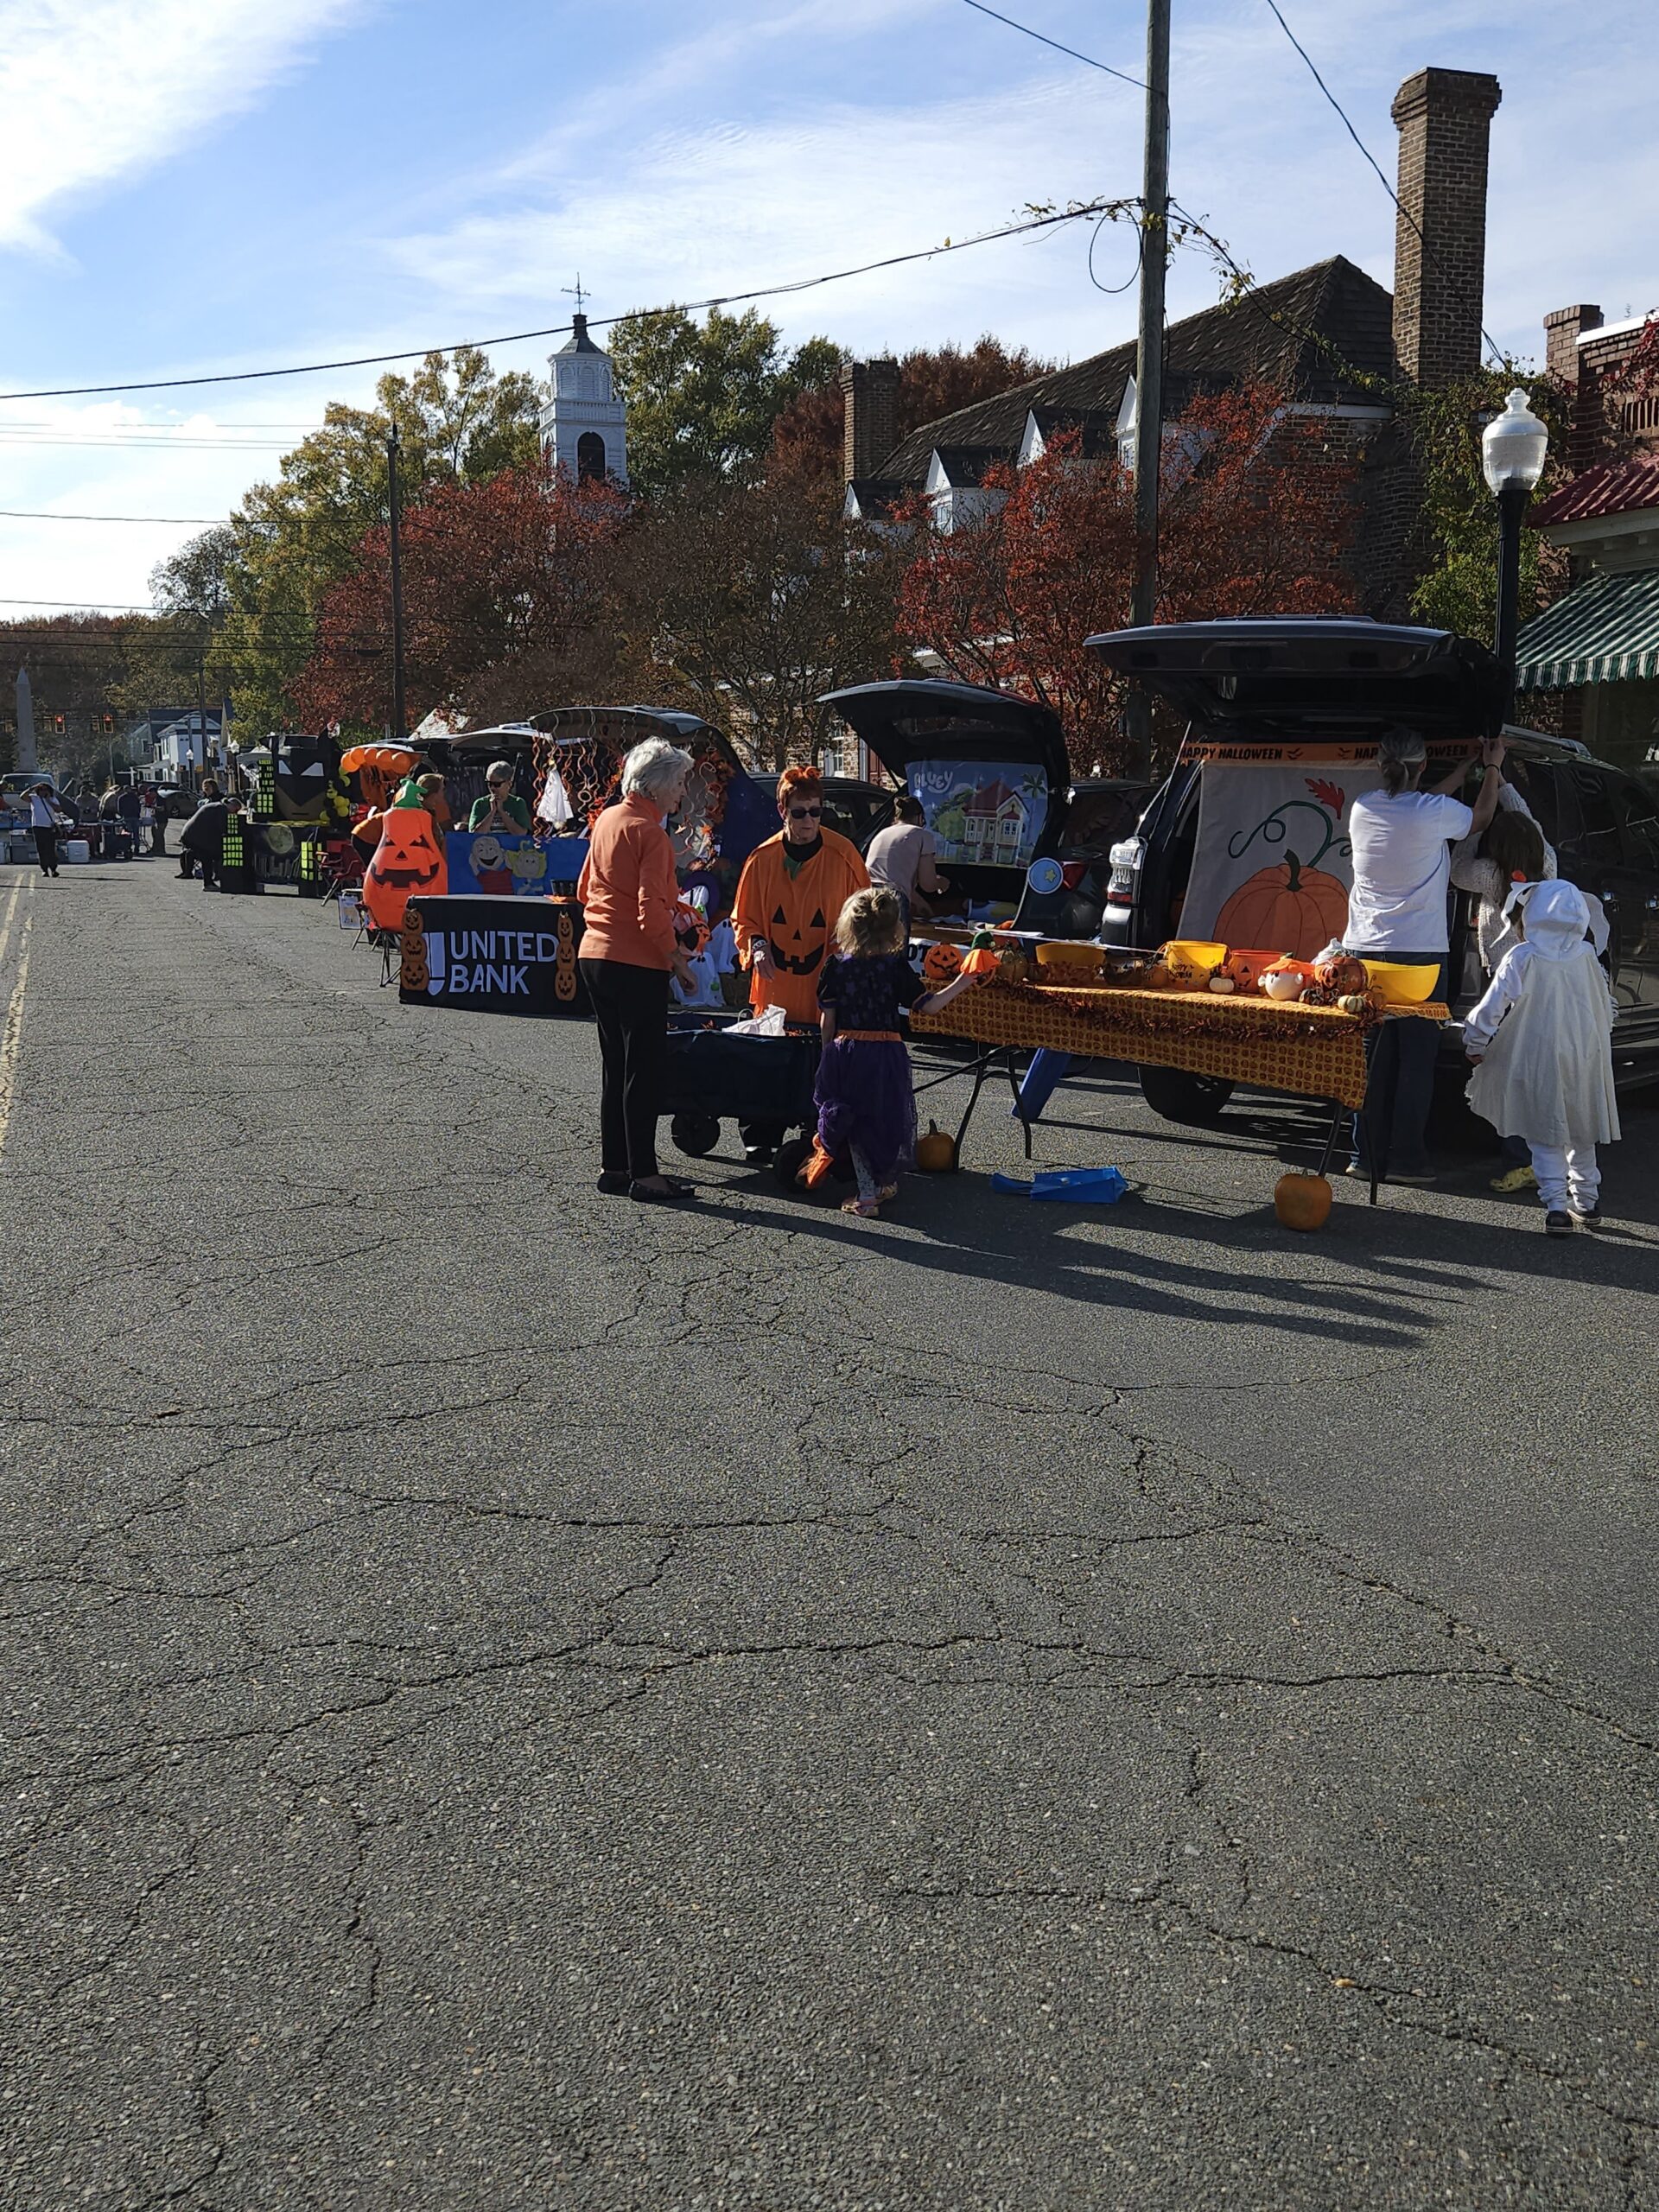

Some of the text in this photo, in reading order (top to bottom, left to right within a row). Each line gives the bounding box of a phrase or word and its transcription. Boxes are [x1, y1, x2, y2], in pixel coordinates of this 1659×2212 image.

[1181, 747, 1283, 760] HAPPY HALLOWEEN
[1355, 747, 1379, 760] HAP
[450, 931, 560, 963] UNITED
[448, 964, 531, 995] BANK
